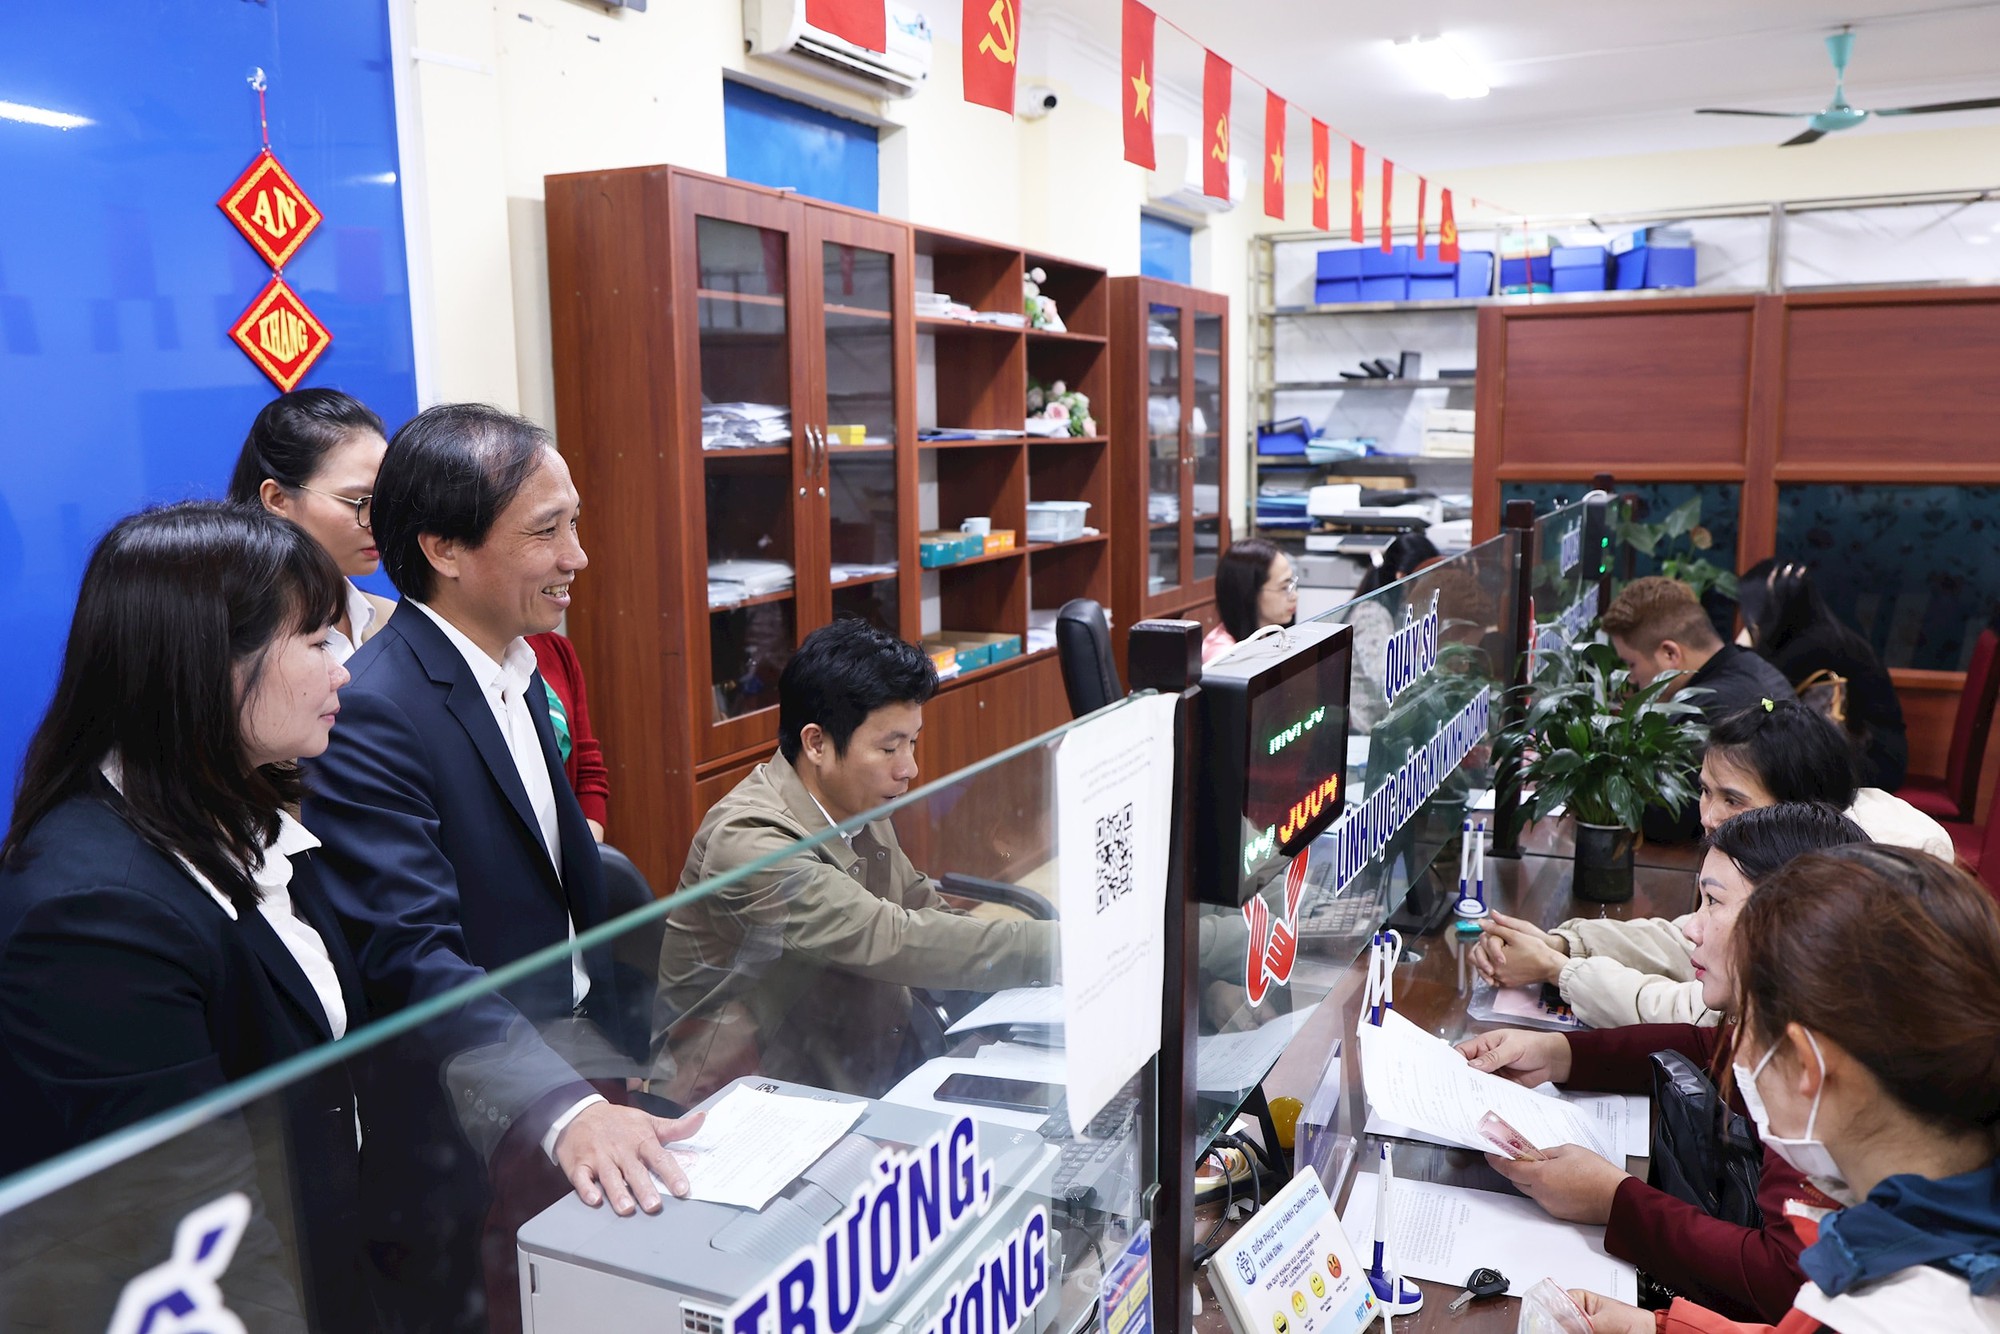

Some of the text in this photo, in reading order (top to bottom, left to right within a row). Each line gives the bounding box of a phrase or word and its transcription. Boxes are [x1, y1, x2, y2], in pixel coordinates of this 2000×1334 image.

[250, 186, 298, 239] AN
[257, 306, 318, 363] KHANG
[1421, 592, 1439, 673] SỐ
[1337, 687, 1489, 892] LĨNH VỰC ĐĂNG KÝ KINH DOANH
[1282, 1207, 1296, 1226] HÀNH
[1293, 1196, 1309, 1214] CHÍNH
[1306, 1184, 1320, 1201] CÔNG
[927, 1214, 1044, 1334] ƠNG
[1355, 1302, 1367, 1322] HPT
